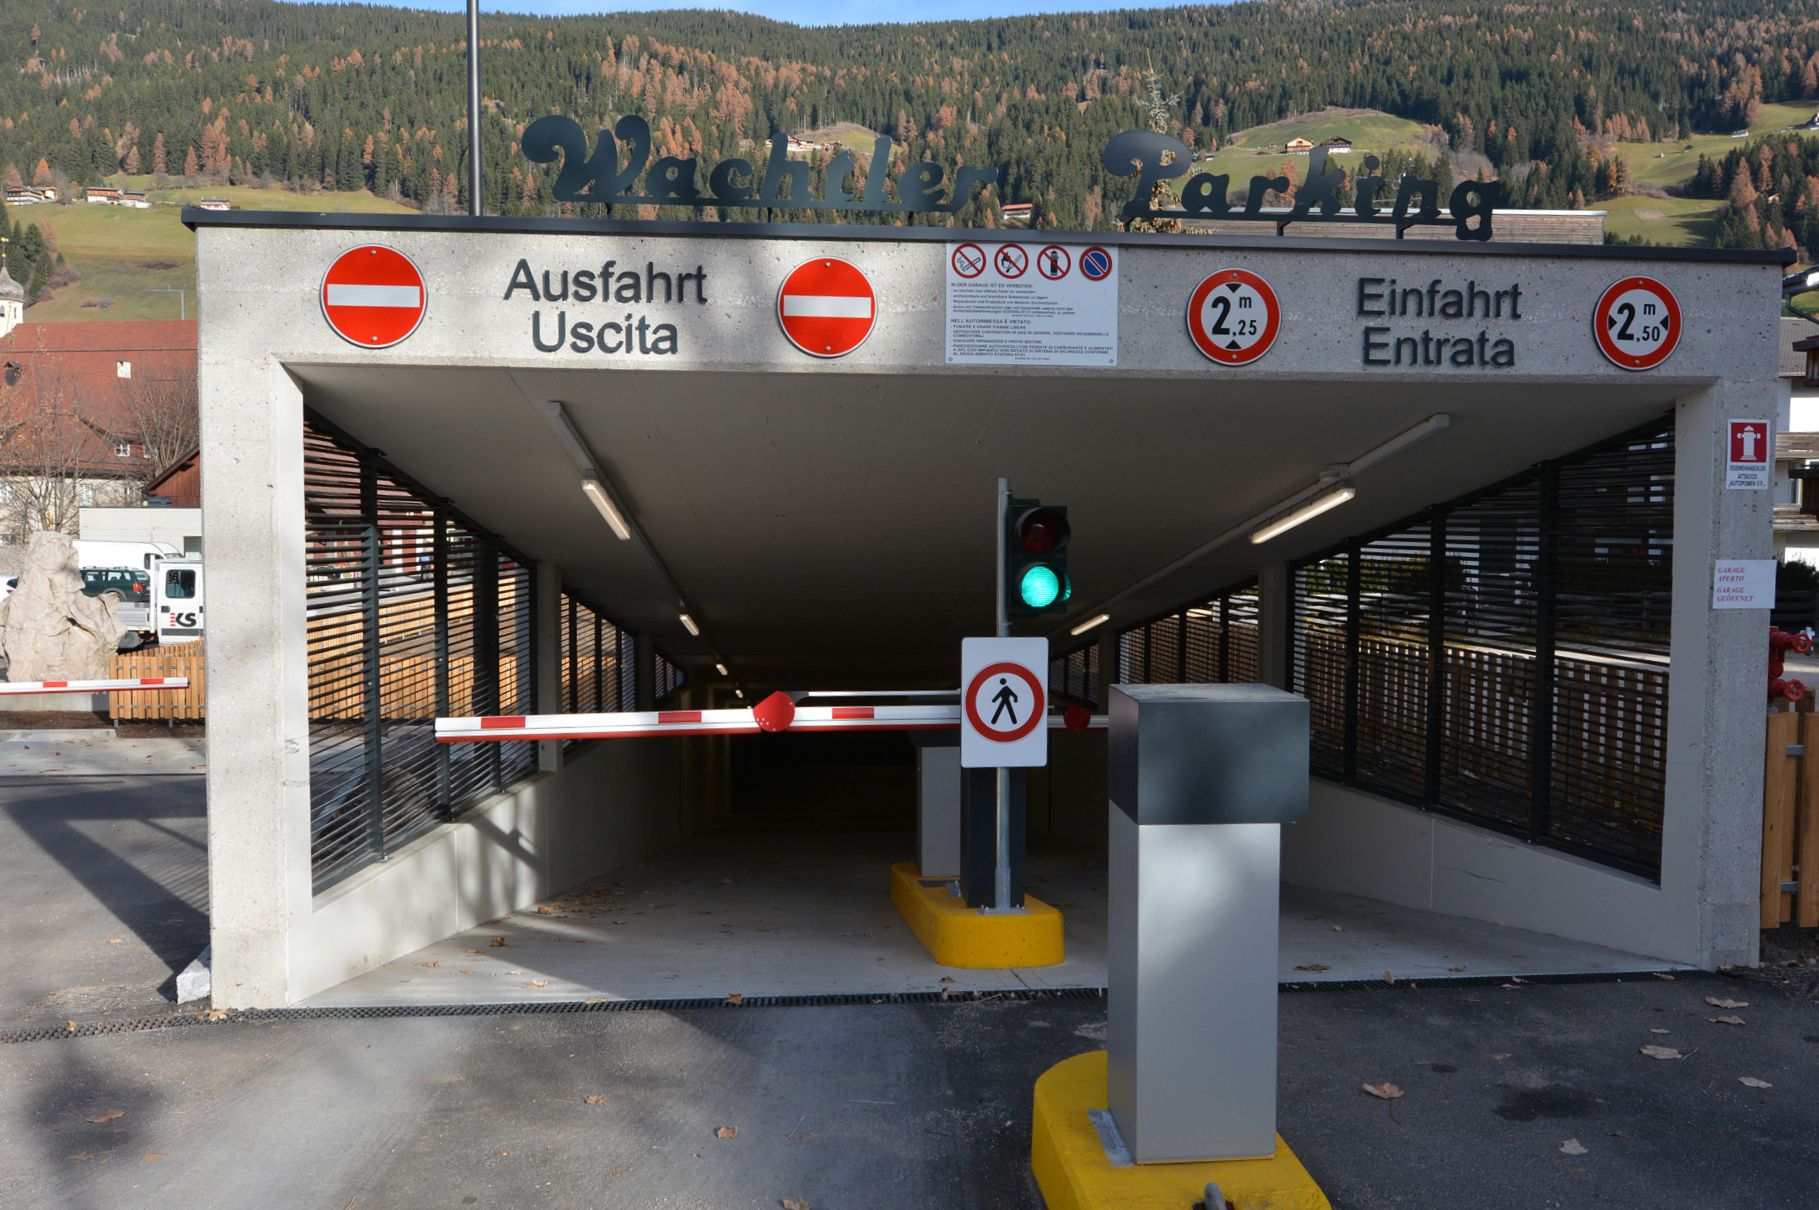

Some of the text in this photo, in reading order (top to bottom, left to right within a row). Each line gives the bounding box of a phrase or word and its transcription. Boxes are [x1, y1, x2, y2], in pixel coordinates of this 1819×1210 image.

[521, 114, 1503, 240] Wachtler Parking
[504, 258, 708, 305] Ausfahrt
[1358, 277, 1523, 320] Einfahrt
[532, 310, 678, 355] Uscita
[1363, 326, 1515, 367] Entrata
